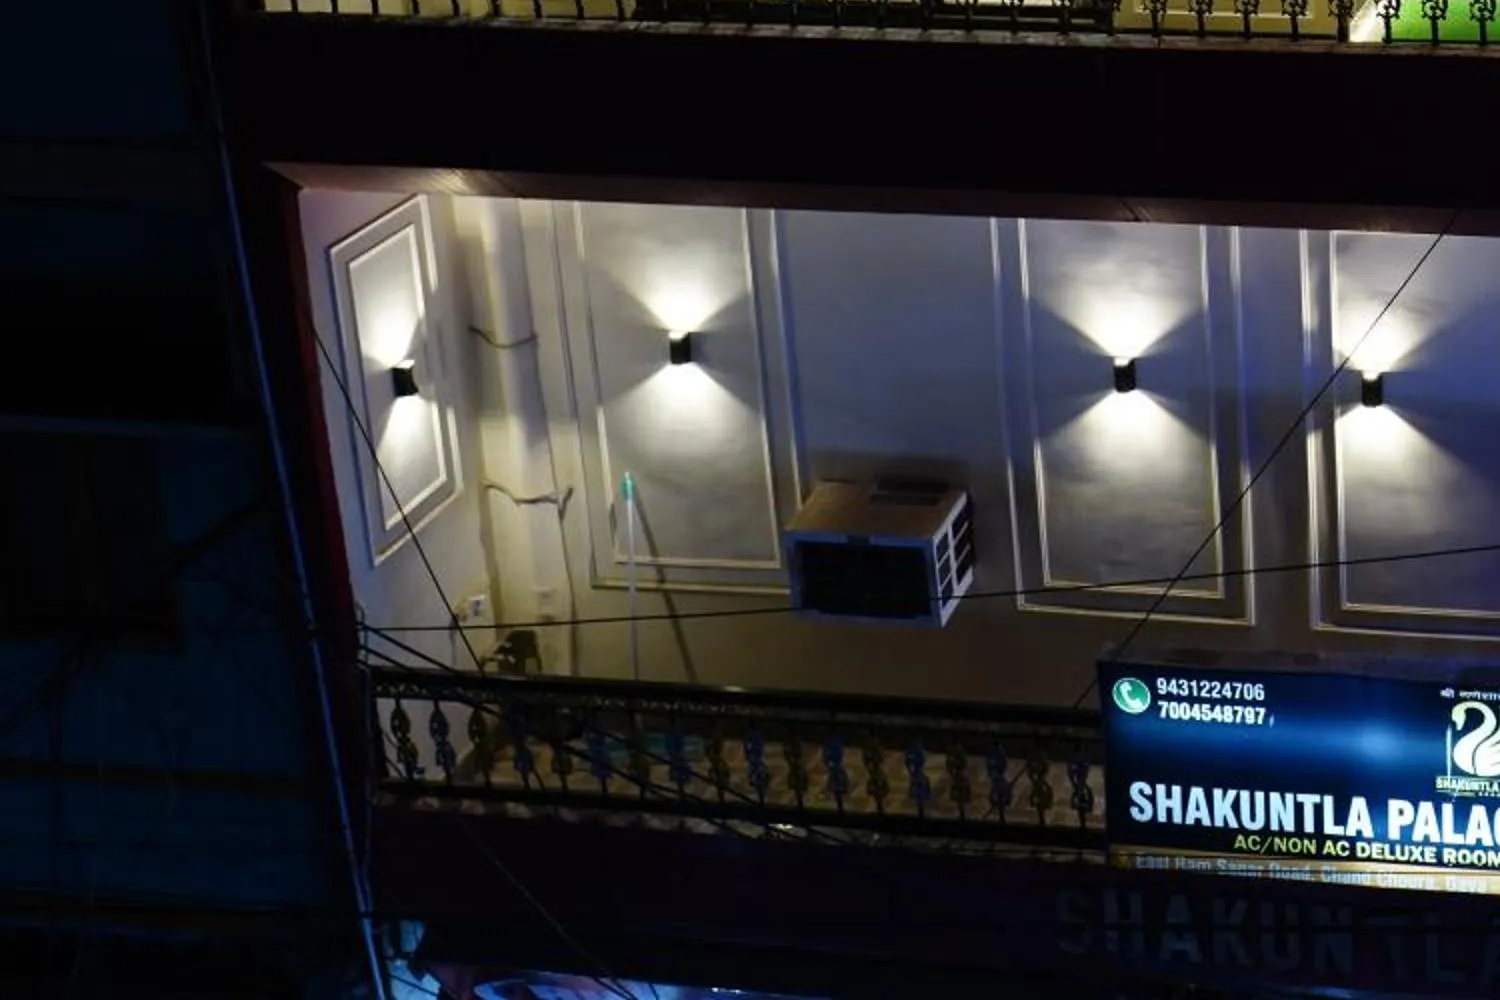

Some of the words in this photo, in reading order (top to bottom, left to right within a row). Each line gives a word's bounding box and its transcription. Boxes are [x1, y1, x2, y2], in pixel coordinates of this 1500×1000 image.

[1156, 677, 1265, 701] 9431224706
[1129, 781, 1375, 840] SHAKUNTLA
[1233, 834, 1317, 855] AC/NON
[1322, 840, 1350, 857] AC
[1356, 842, 1438, 863] DELUXE
